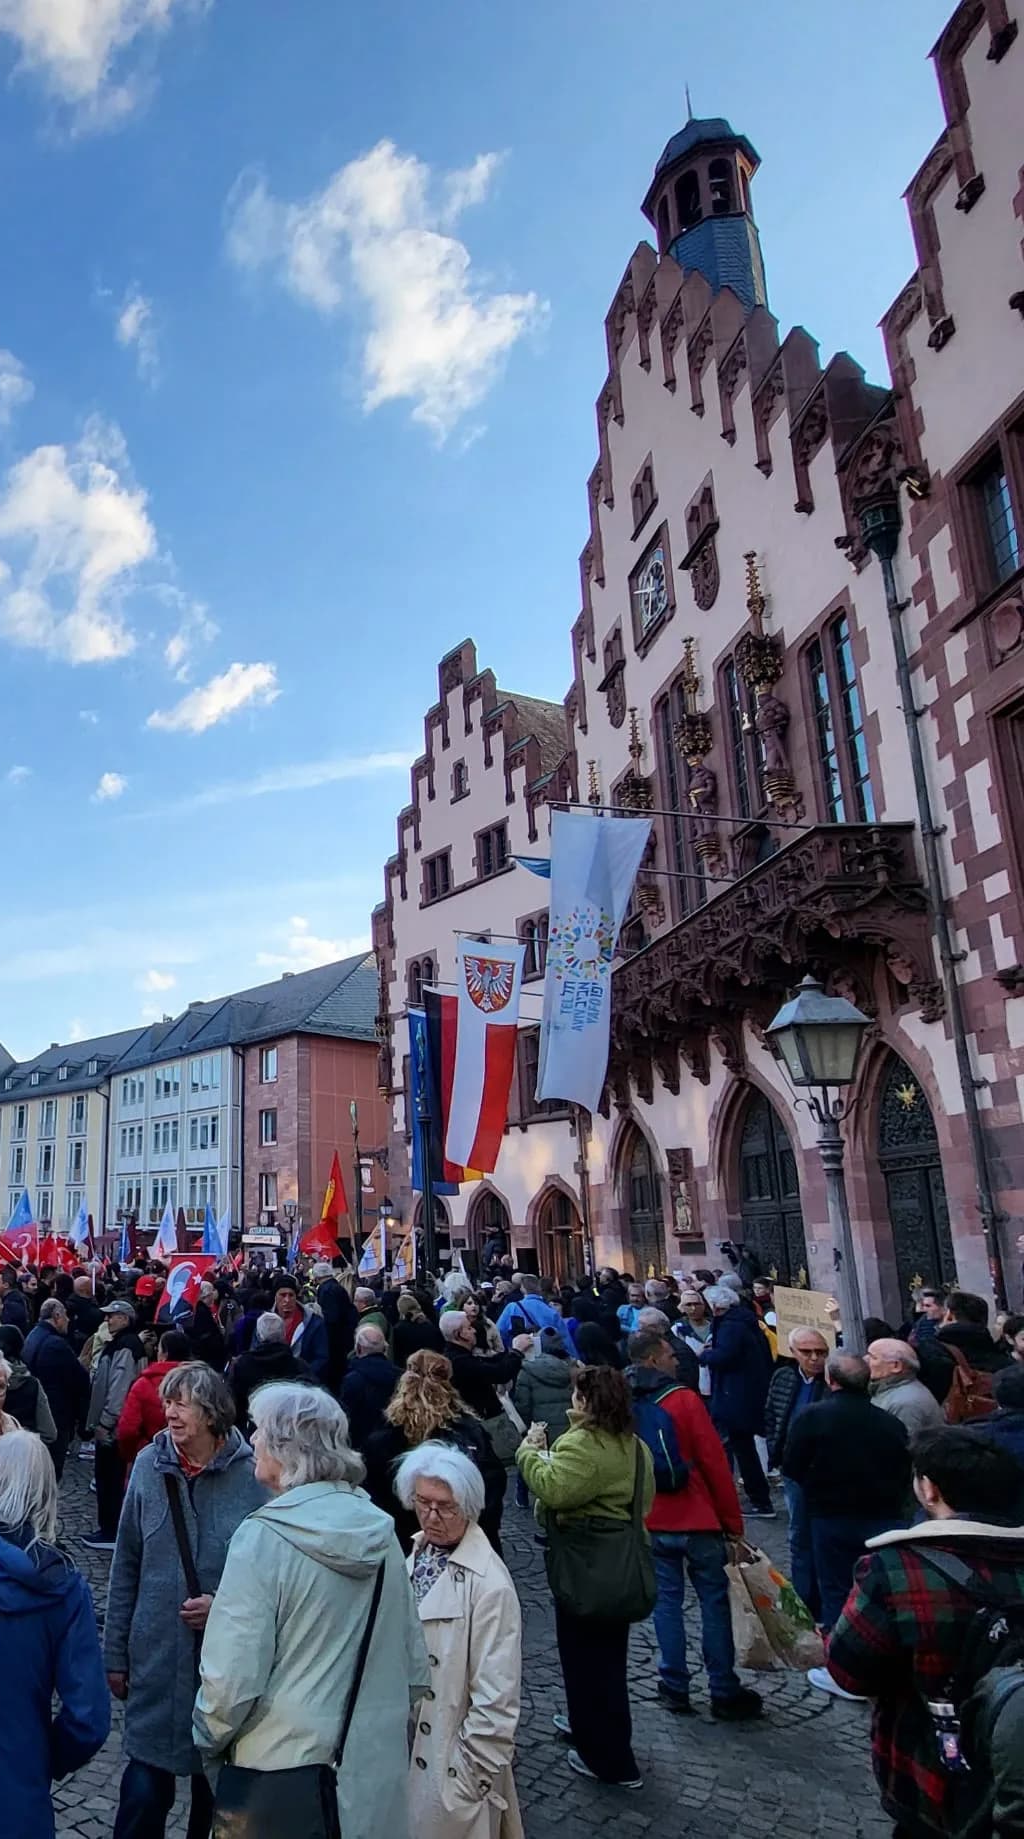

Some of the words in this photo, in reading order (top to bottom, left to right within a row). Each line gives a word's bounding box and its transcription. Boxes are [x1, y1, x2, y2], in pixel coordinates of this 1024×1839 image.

[559, 997, 574, 1016] TEL
[575, 982, 590, 1008] אביב
[571, 1009, 584, 1032] AVIV
[586, 998, 601, 1024] YAFO
